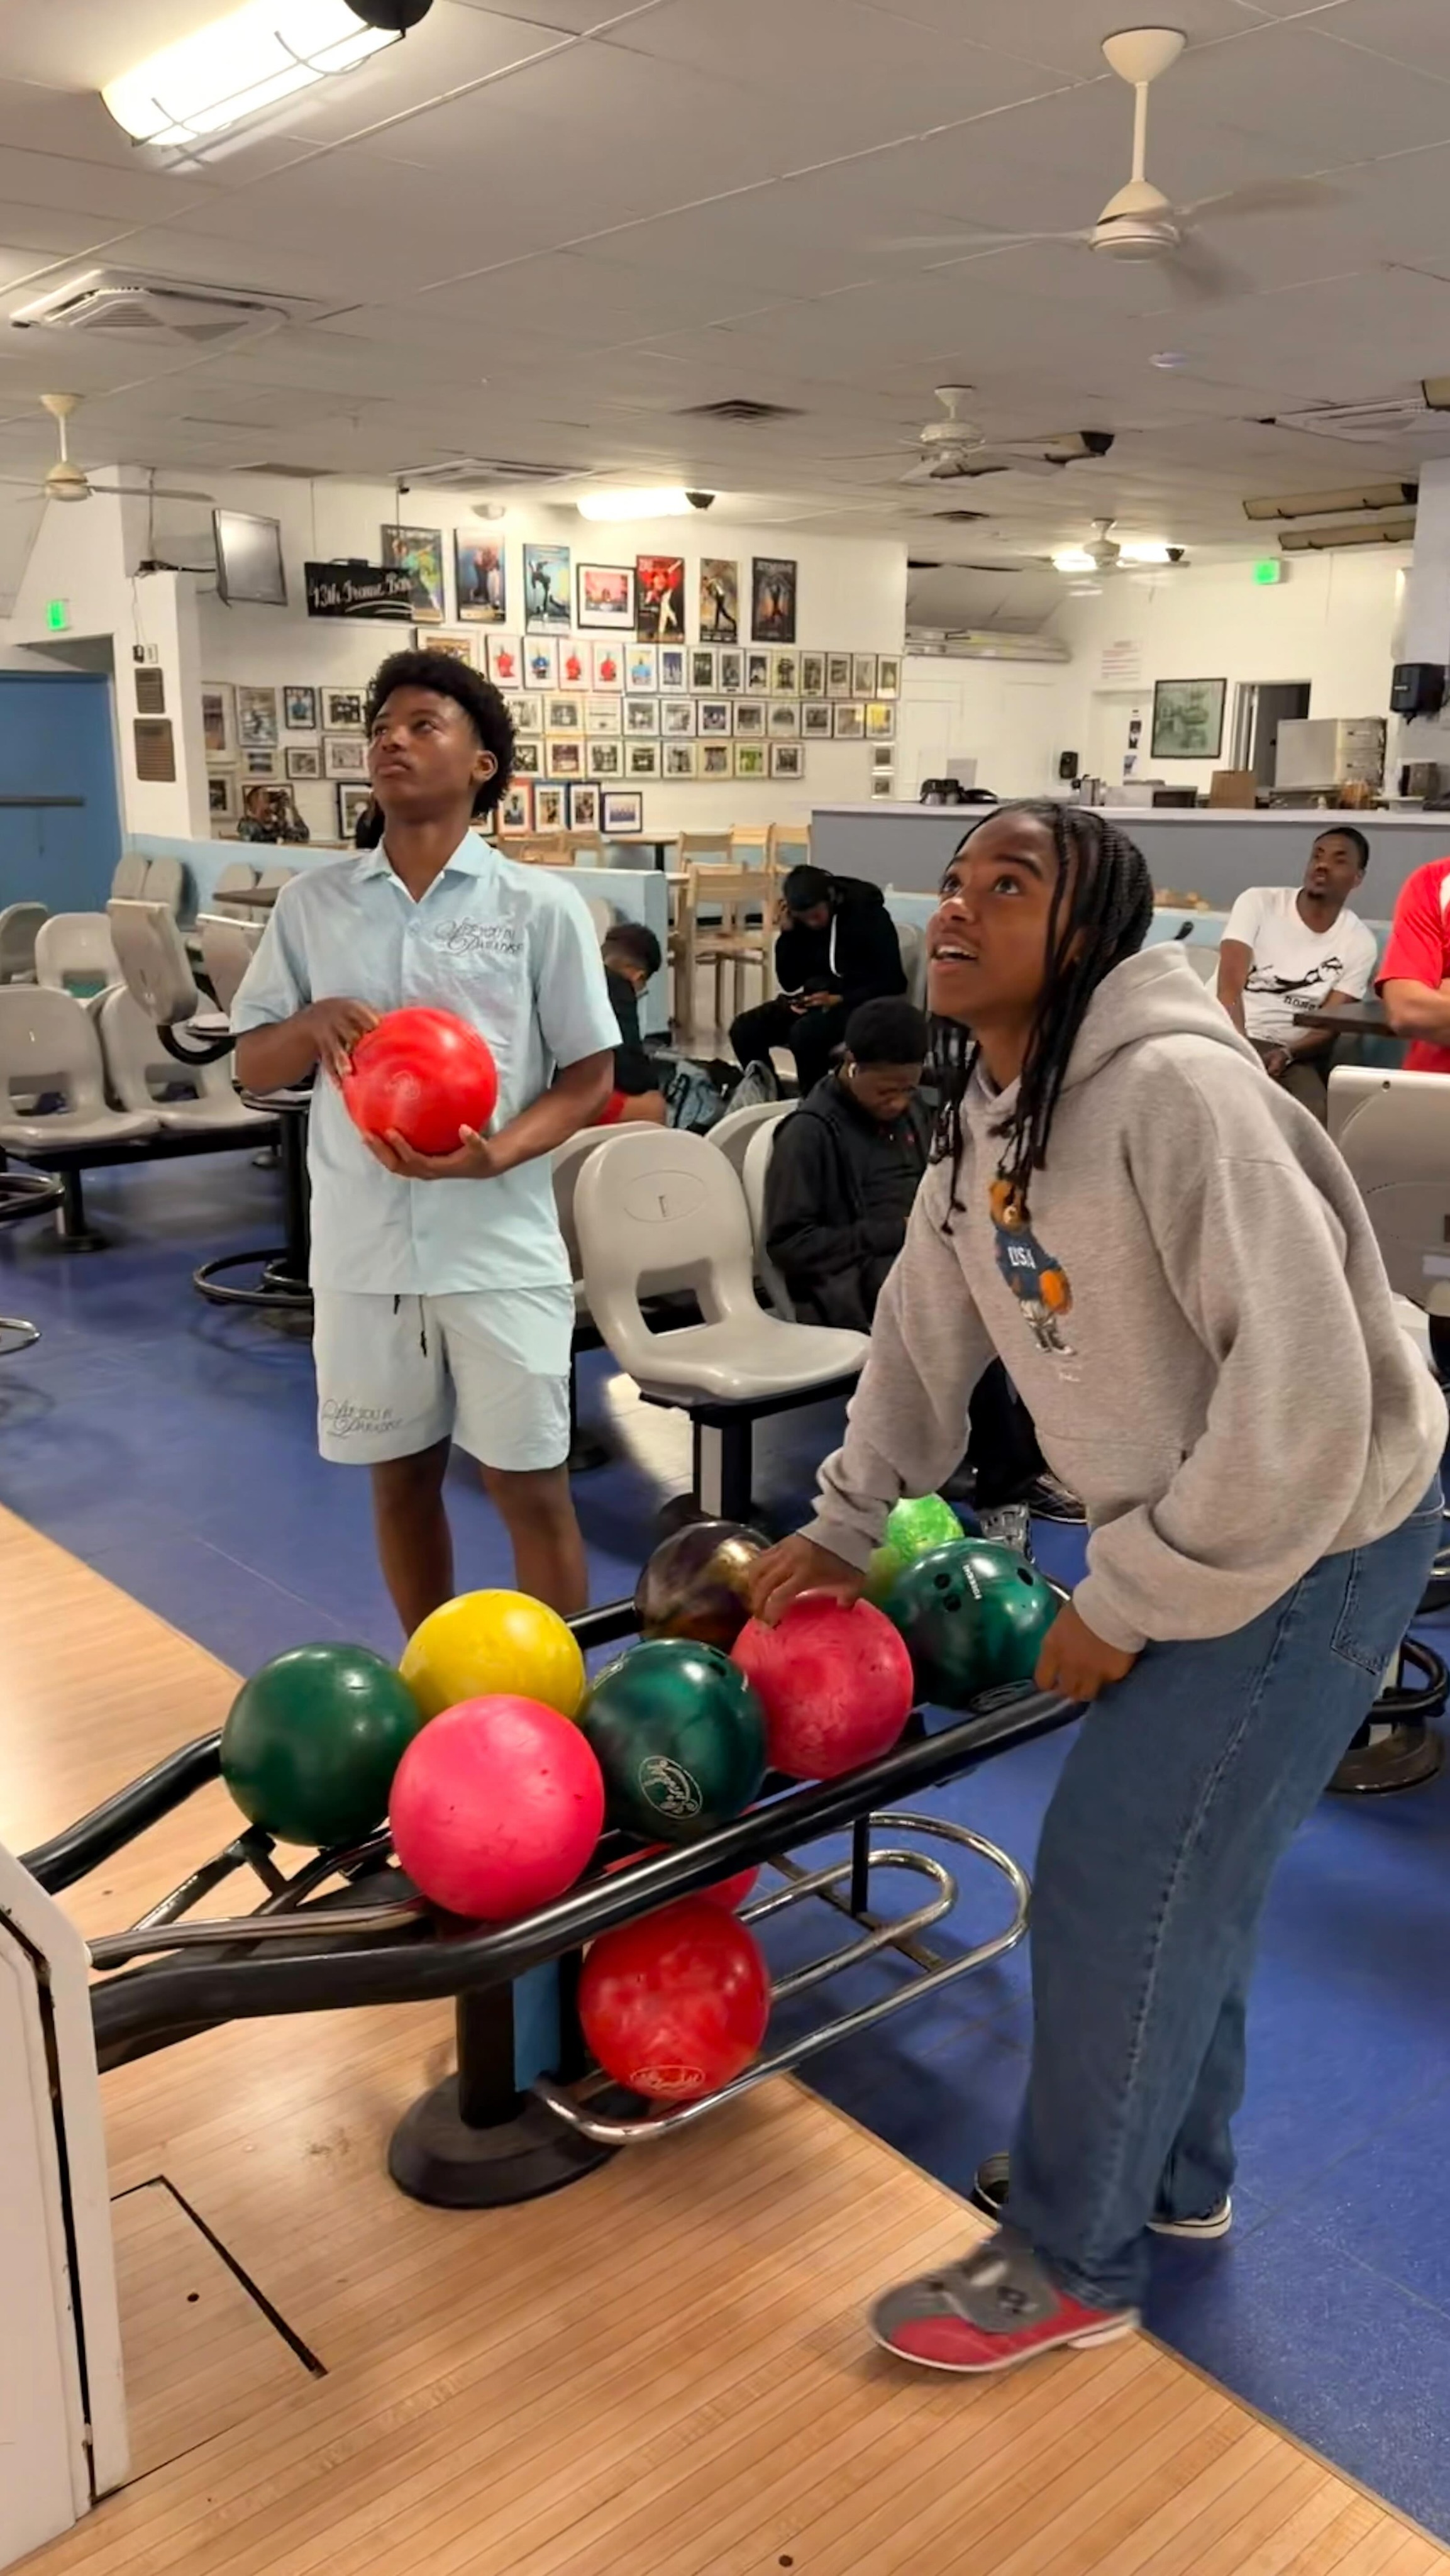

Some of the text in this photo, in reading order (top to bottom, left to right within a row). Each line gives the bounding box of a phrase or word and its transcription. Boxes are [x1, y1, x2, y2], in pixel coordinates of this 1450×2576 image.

[313, 583, 341, 608] 13th
[343, 579, 385, 603] Frame
[1007, 1245, 1037, 1269] USA
